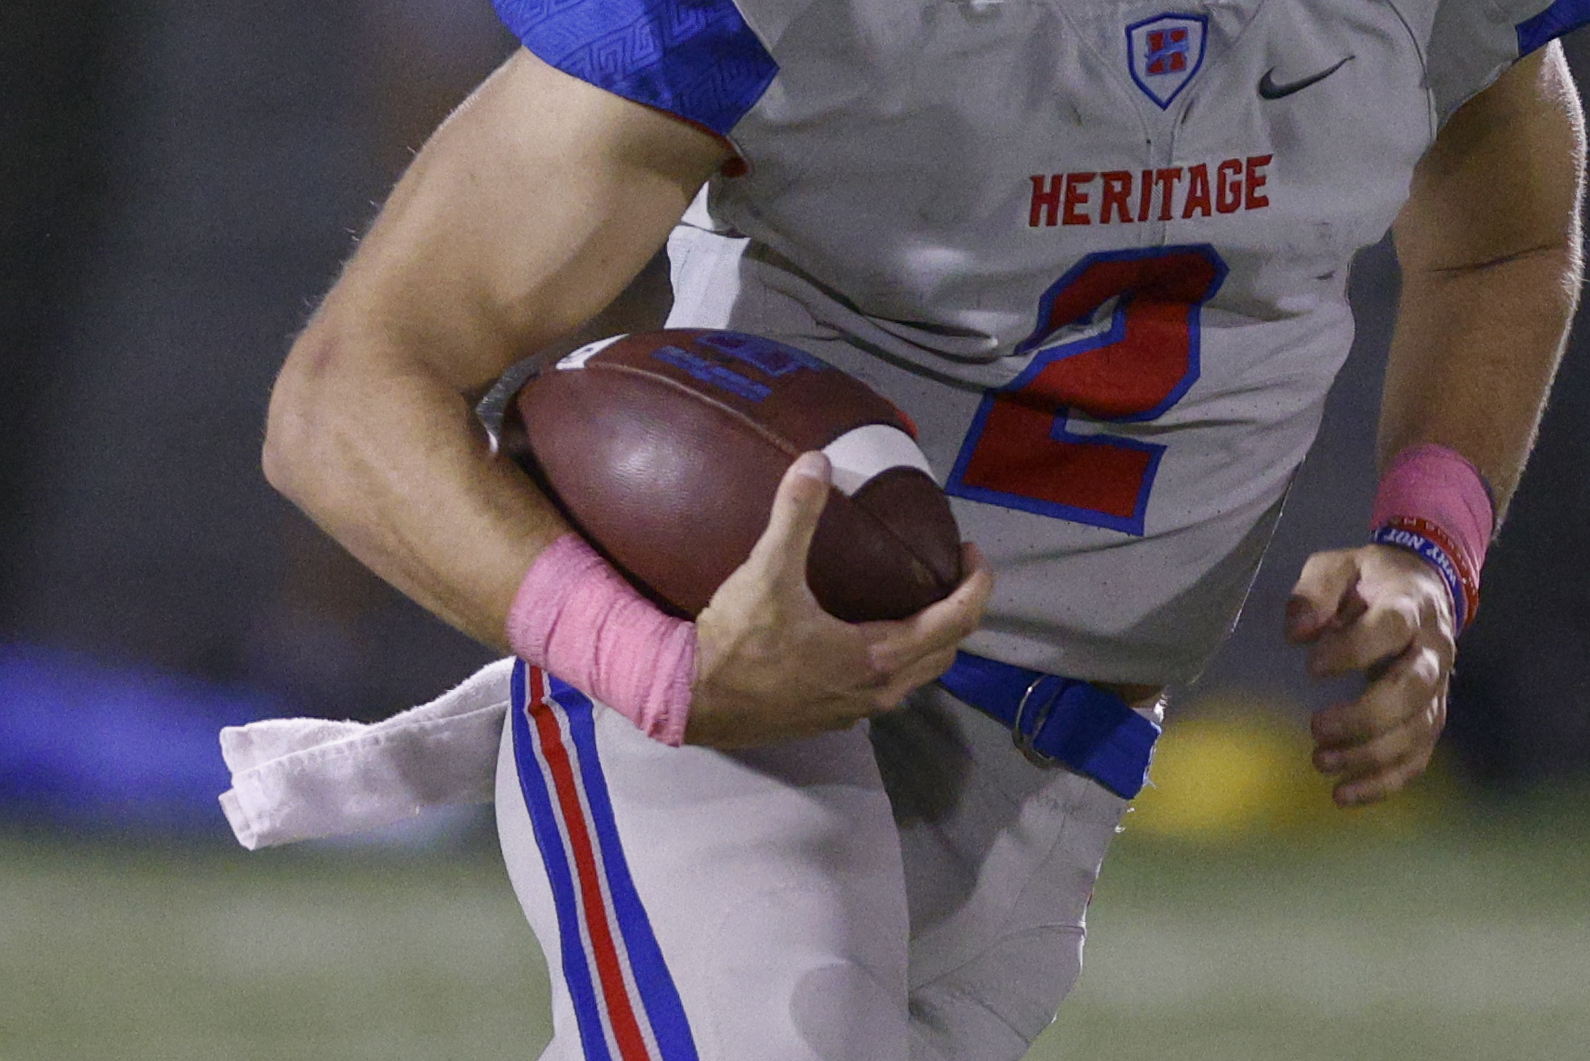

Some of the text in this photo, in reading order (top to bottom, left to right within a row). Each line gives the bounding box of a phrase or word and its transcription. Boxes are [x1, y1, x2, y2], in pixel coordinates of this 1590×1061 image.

[1028, 153, 1275, 228] HERITAGE
[944, 242, 1231, 538] 2
[1384, 528, 1426, 551] NOT
